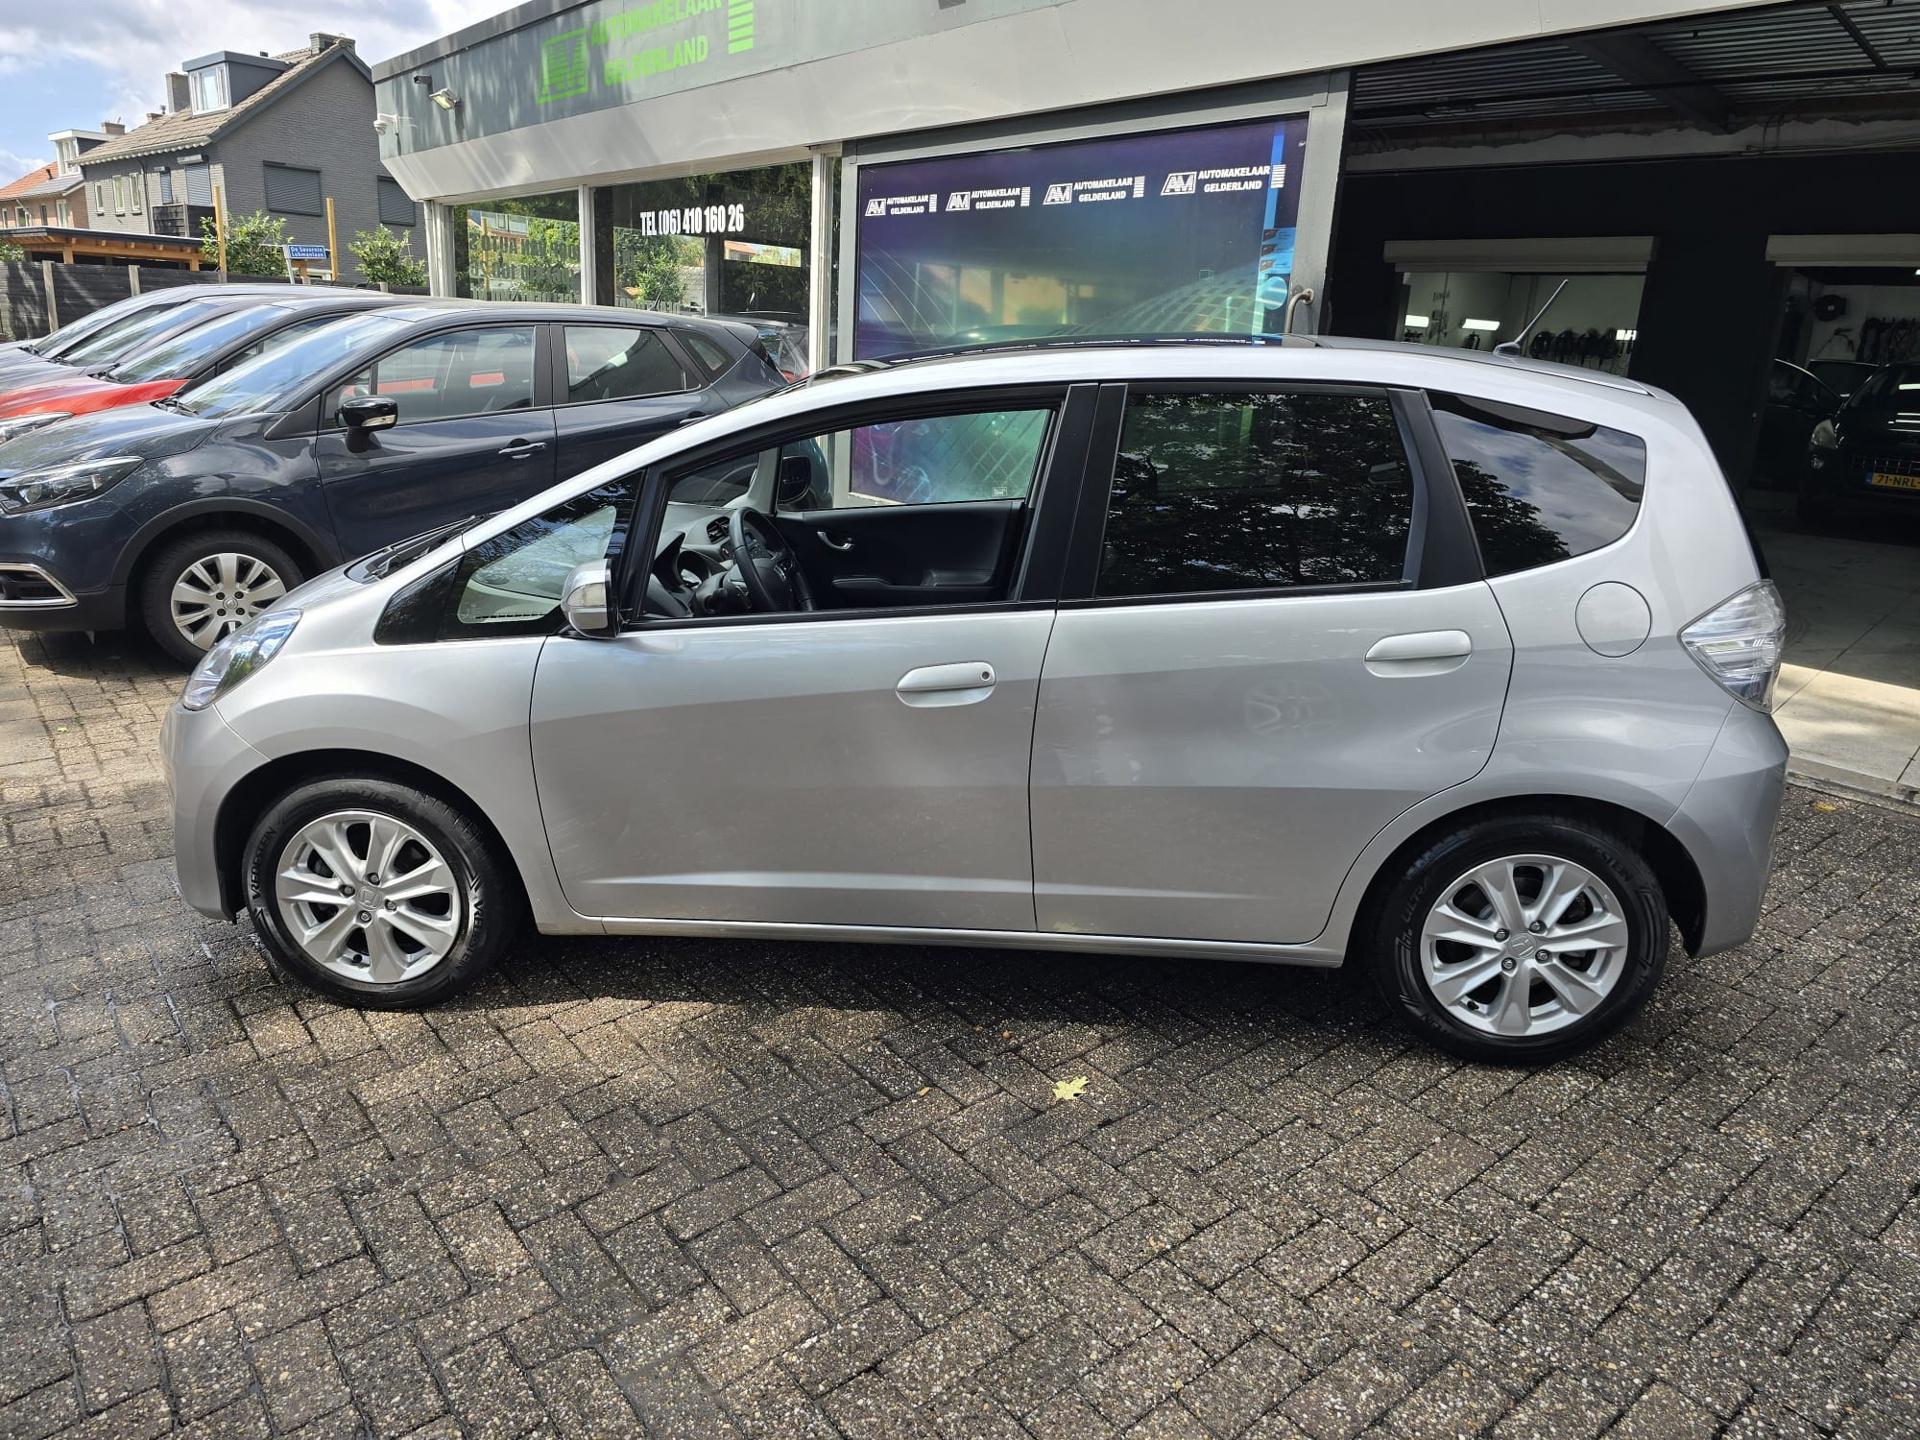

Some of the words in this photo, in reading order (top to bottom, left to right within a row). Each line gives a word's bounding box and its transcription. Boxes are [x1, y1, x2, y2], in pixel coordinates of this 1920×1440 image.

[1197, 165, 1270, 179] AUTOMAKELAAR
[1073, 177, 1133, 191] AUTOMAKELAAR
[1204, 180, 1262, 192] GELDERLAND
[971, 187, 1021, 199] AUTOMAKELAAR
[1078, 190, 1127, 202] GELDERLAND
[640, 211, 657, 236] TEL
[658, 208, 681, 235] (06)
[682, 206, 702, 234] 410
[703, 204, 726, 233] 160
[728, 203, 744, 232] 26
